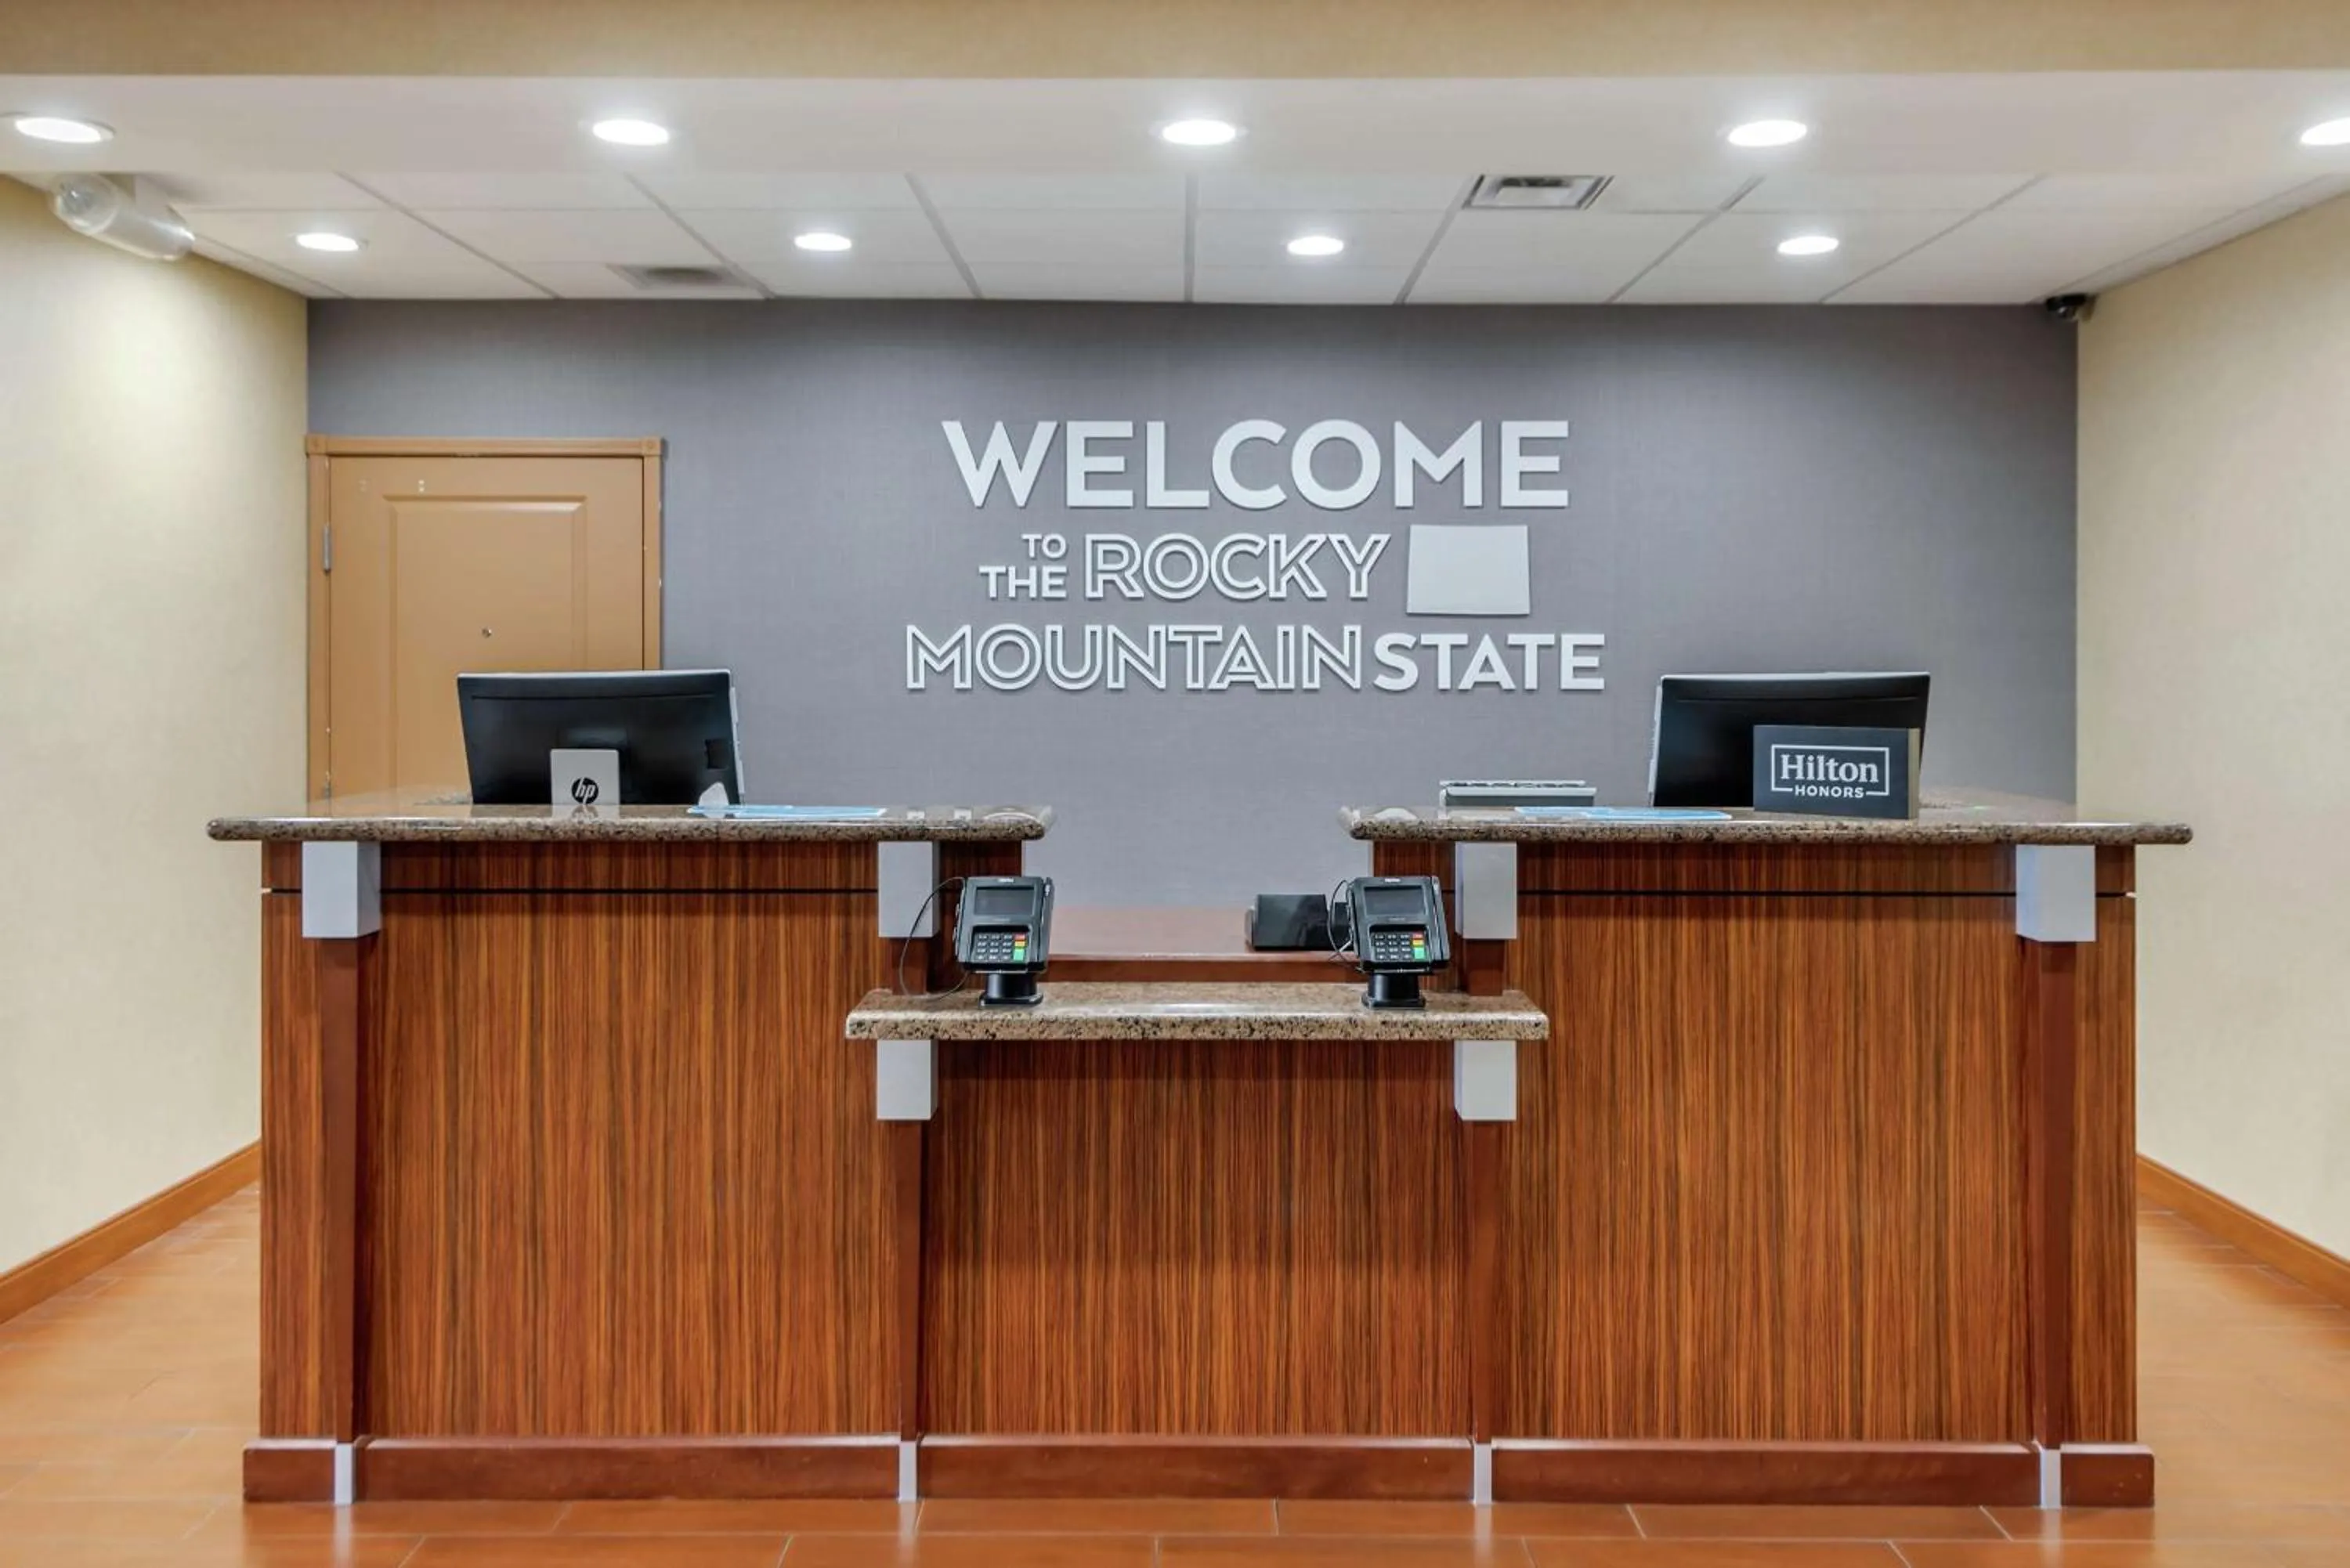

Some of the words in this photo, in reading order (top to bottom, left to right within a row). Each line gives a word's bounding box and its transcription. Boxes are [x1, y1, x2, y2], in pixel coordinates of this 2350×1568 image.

[941, 418, 1570, 509] WELCOME
[1021, 534, 1066, 559] TO
[979, 565, 1067, 599] THE
[1084, 533, 1390, 601] ROCKY
[906, 623, 1362, 692] MOUNTAIN
[1372, 632, 1606, 692] STATE
[1780, 754, 1878, 782] Hilton
[574, 777, 597, 804] hp
[1795, 785, 1864, 798] HONORS
